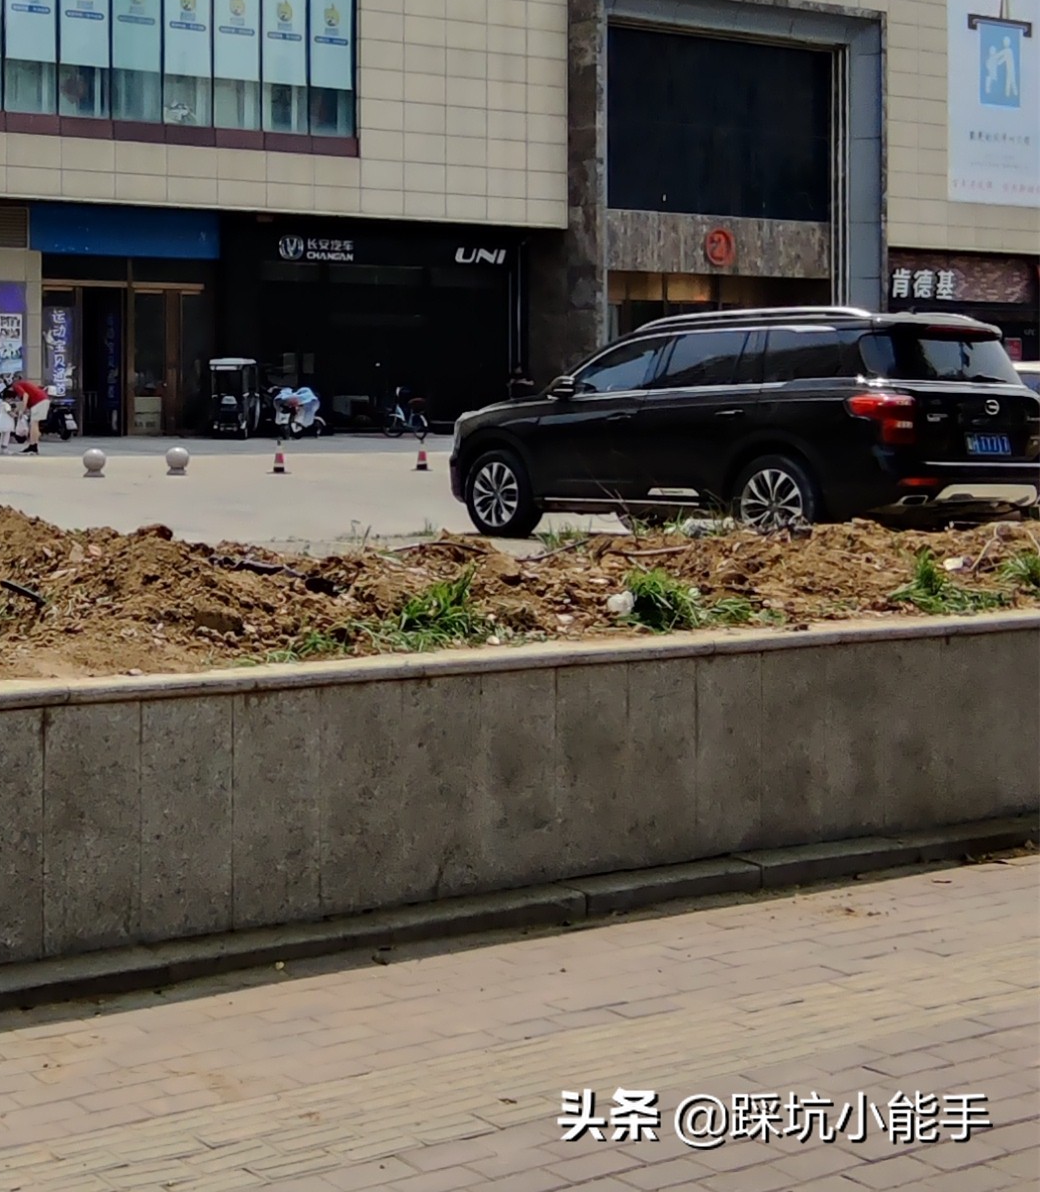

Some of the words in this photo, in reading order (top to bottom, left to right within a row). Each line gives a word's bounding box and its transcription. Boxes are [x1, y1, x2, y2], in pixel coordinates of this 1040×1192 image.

[306, 238, 354, 251] 长安汽车
[306, 250, 354, 262] CHANGAN
[454, 247, 507, 265] UNI
[892, 267, 956, 300] 肯德基
